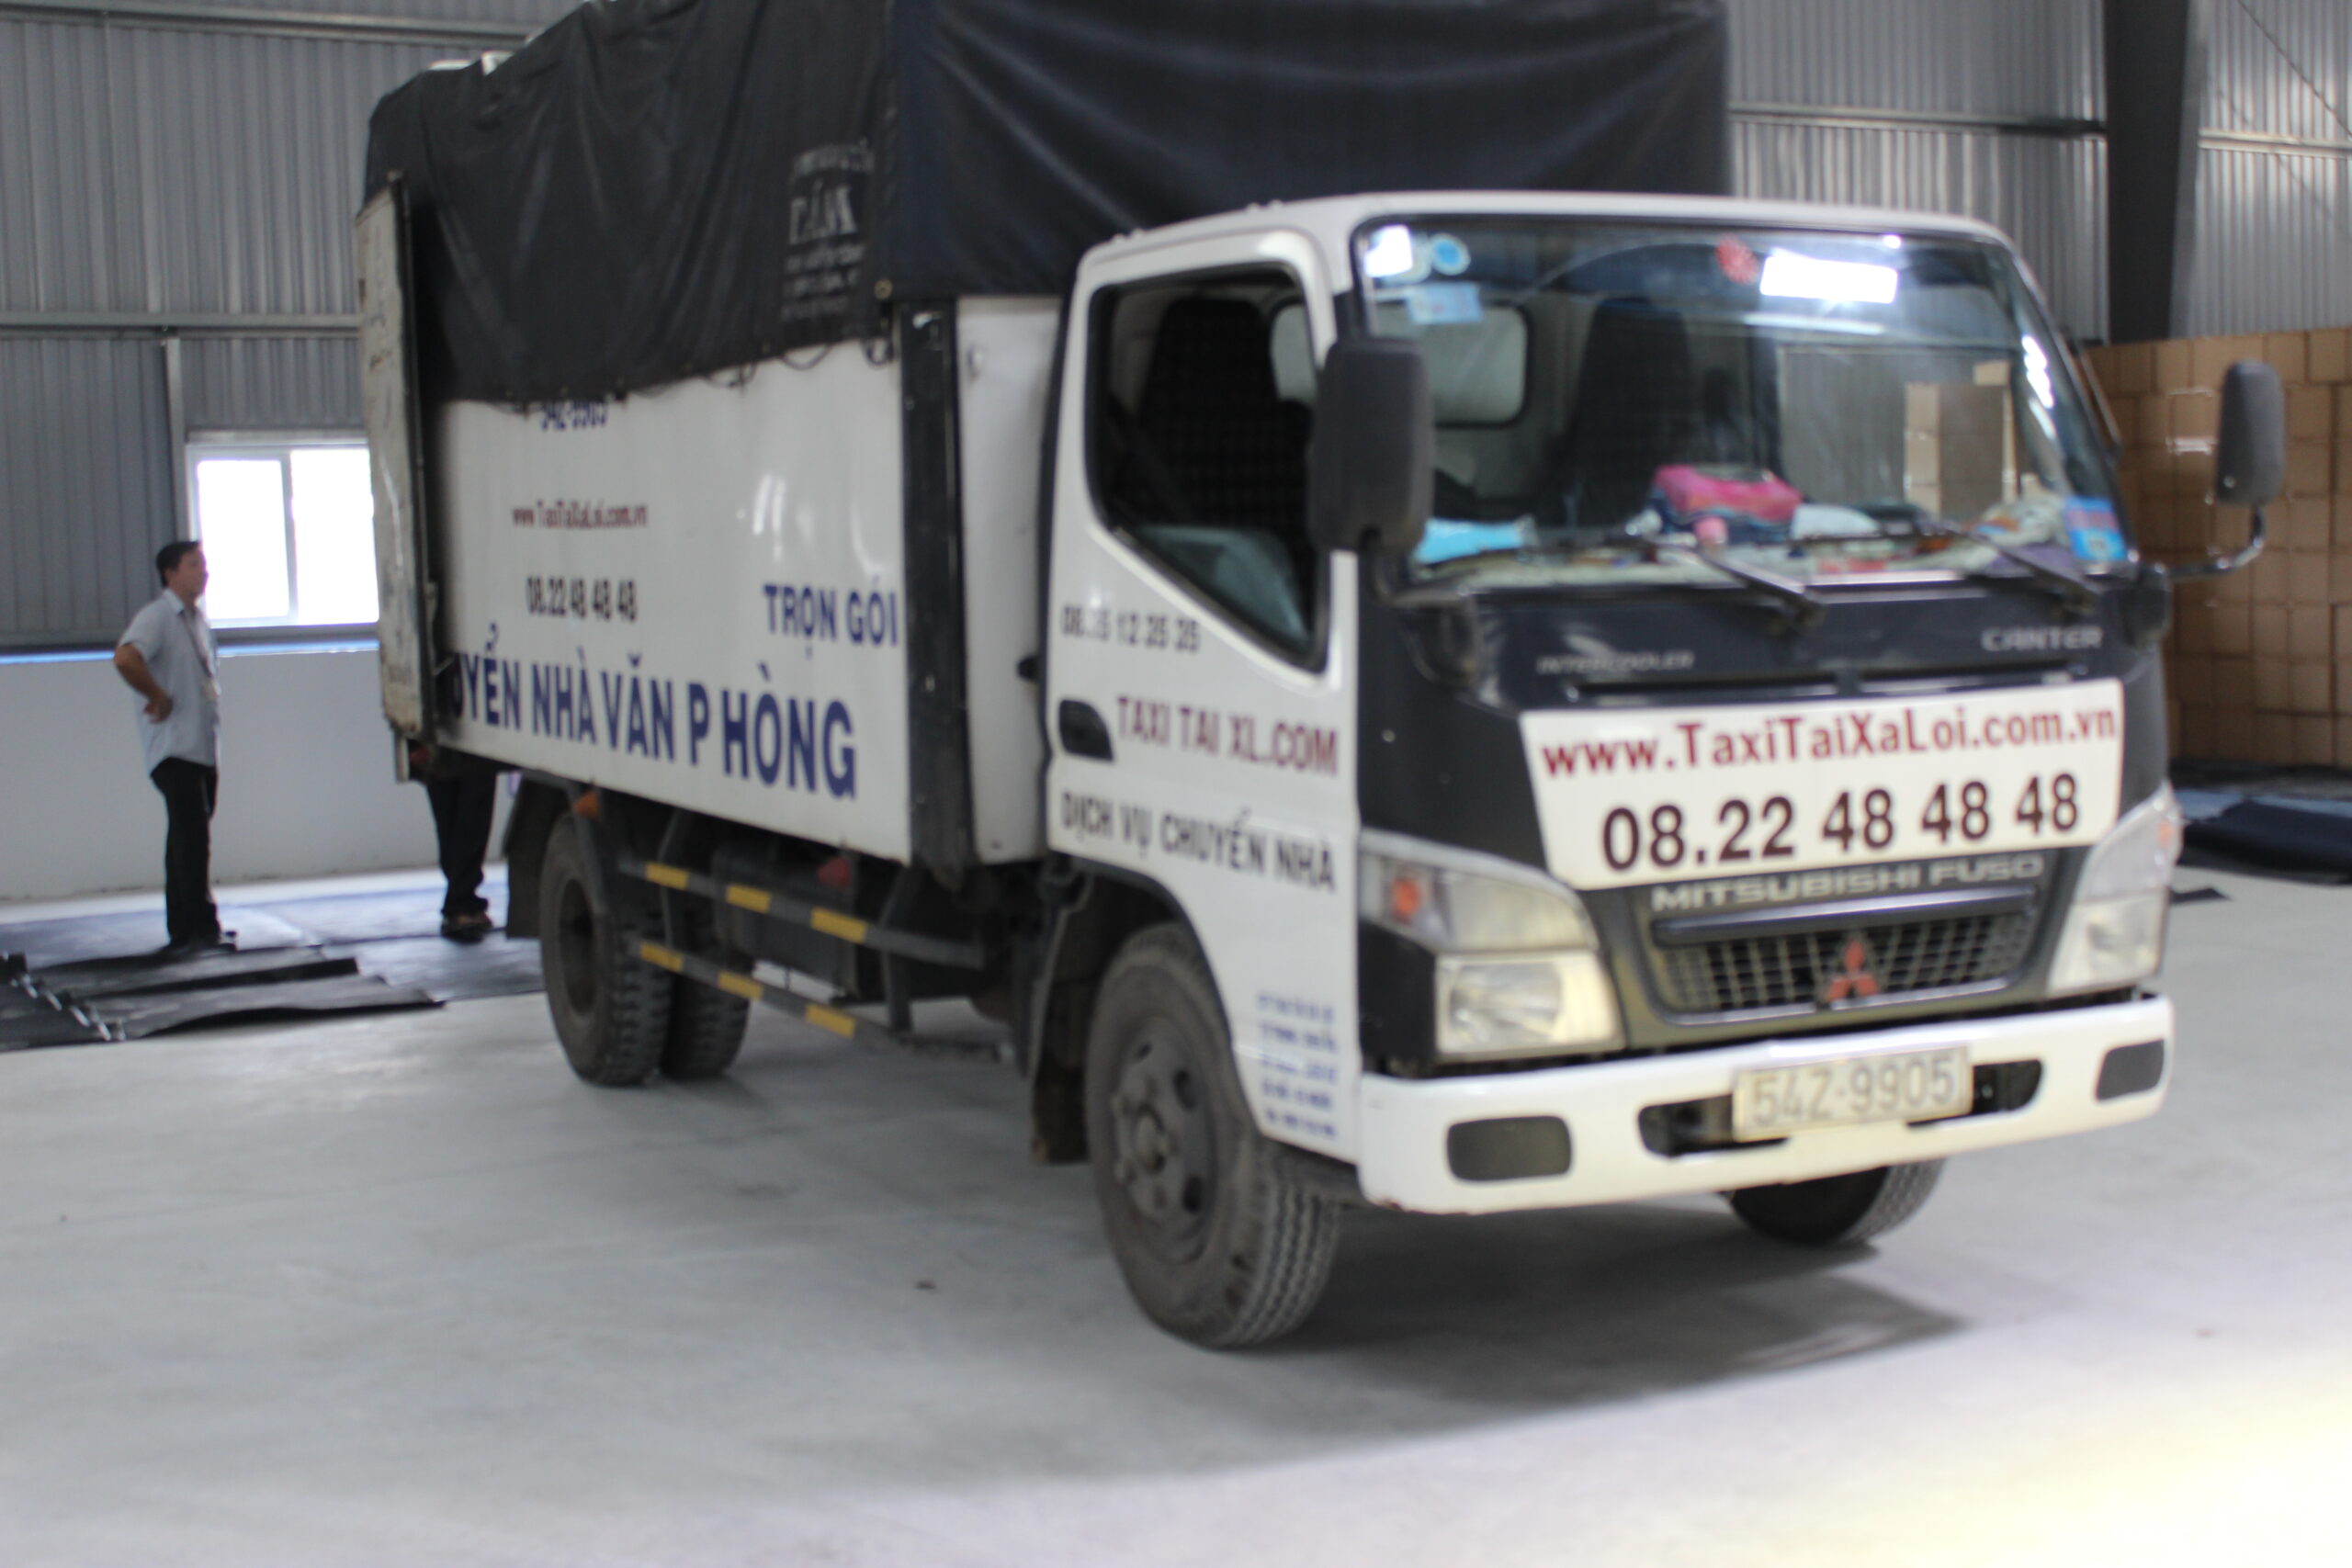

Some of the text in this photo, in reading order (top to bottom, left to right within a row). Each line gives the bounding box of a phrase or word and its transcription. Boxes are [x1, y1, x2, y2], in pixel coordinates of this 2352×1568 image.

[571, 578, 587, 620] 48
[594, 579, 611, 622] 48
[617, 580, 637, 624] 48
[1982, 626, 2103, 652] CANTER
[530, 645, 597, 746] NHÀ
[599, 651, 675, 763] VĂN
[1117, 695, 1171, 748] TAXI
[1542, 705, 2117, 778] www.TaxiTaiXaLoi.com.vn
[1602, 773, 2080, 871] 08.22 48 48 48
[1653, 854, 2045, 912] MITSUBISHI FUSO
[1751, 1056, 1955, 1127] 54Z-9905
